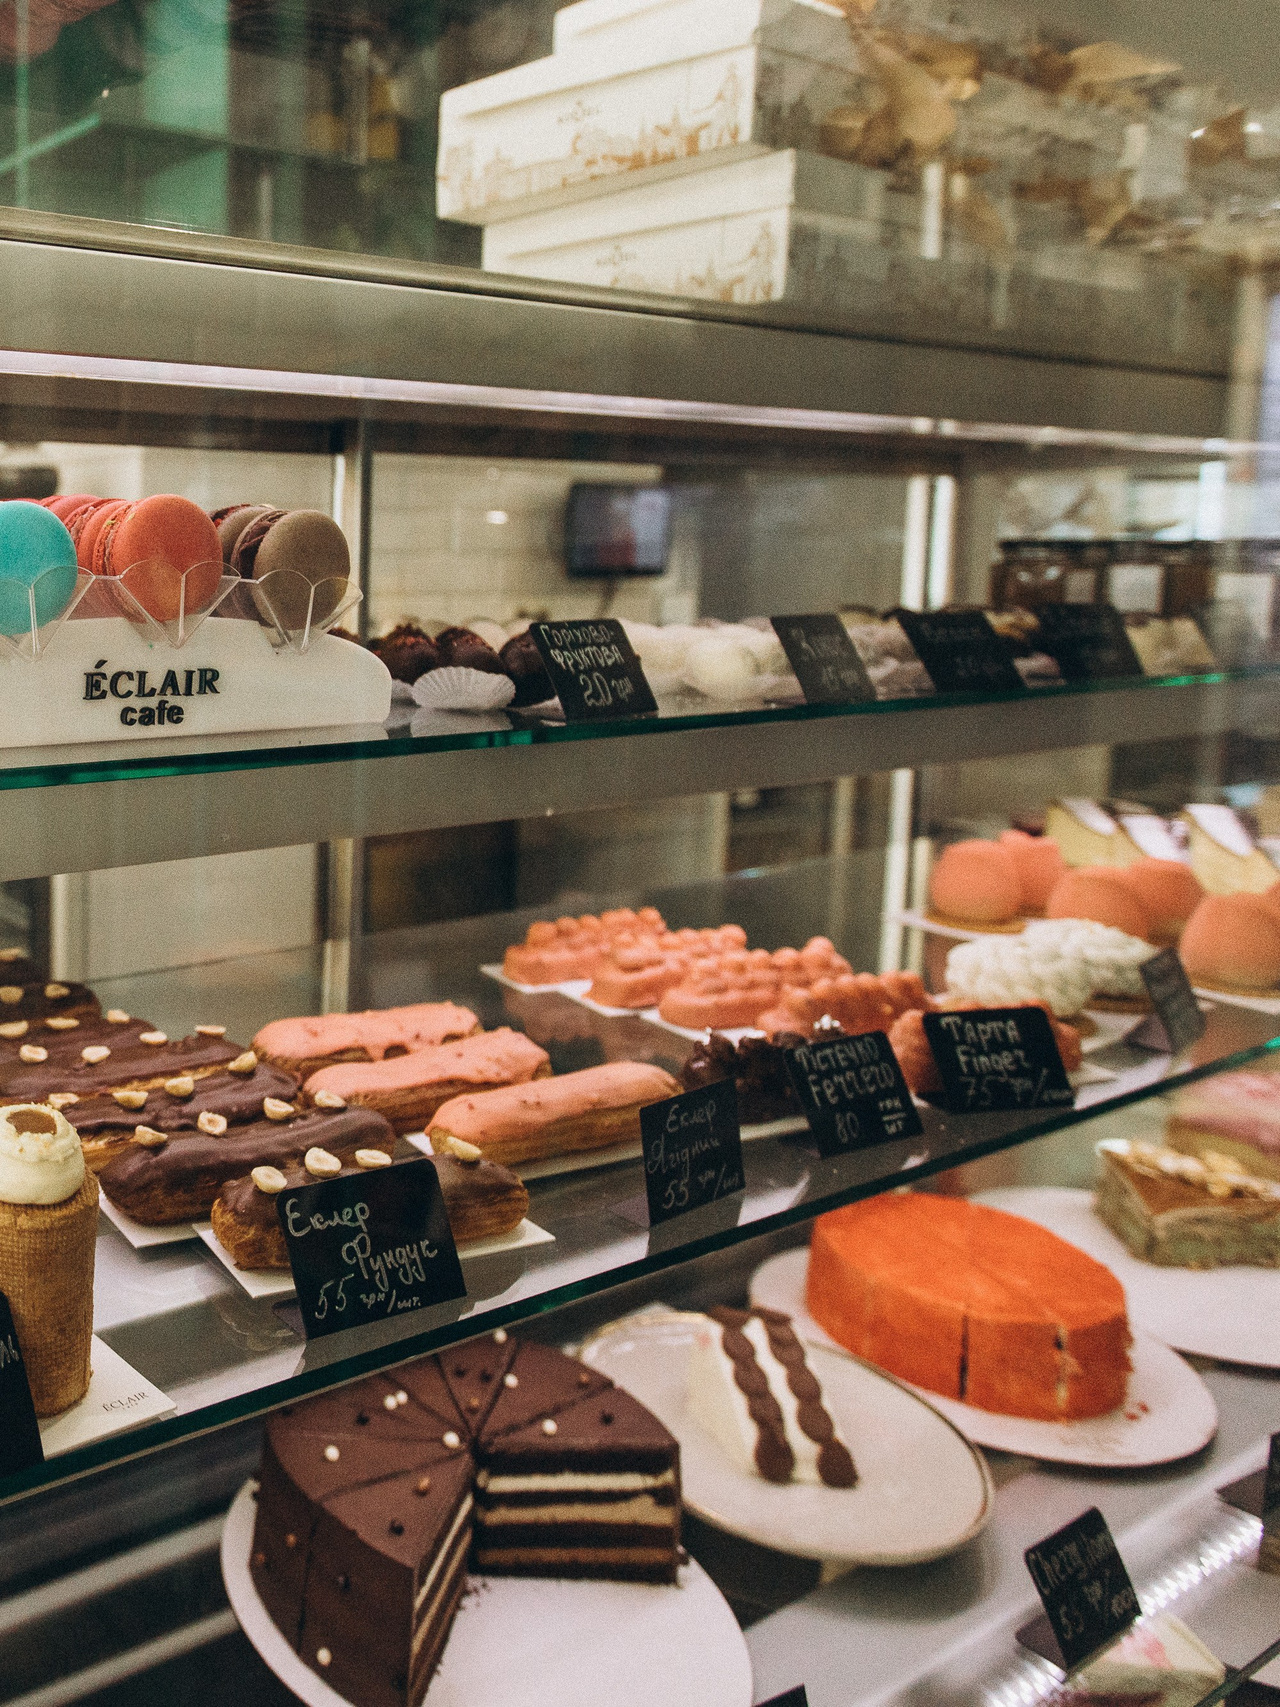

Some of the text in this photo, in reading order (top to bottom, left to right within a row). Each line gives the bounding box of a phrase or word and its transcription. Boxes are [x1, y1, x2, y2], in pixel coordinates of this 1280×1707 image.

[84, 660, 221, 701] ÉCLAIR
[579, 672, 613, 706] 20
[120, 700, 185, 727] cafe
[661, 1178, 689, 1210] 55
[286, 1198, 370, 1237] Еклер
[341, 1232, 438, 1292] Фундук
[315, 1273, 354, 1319] 55
